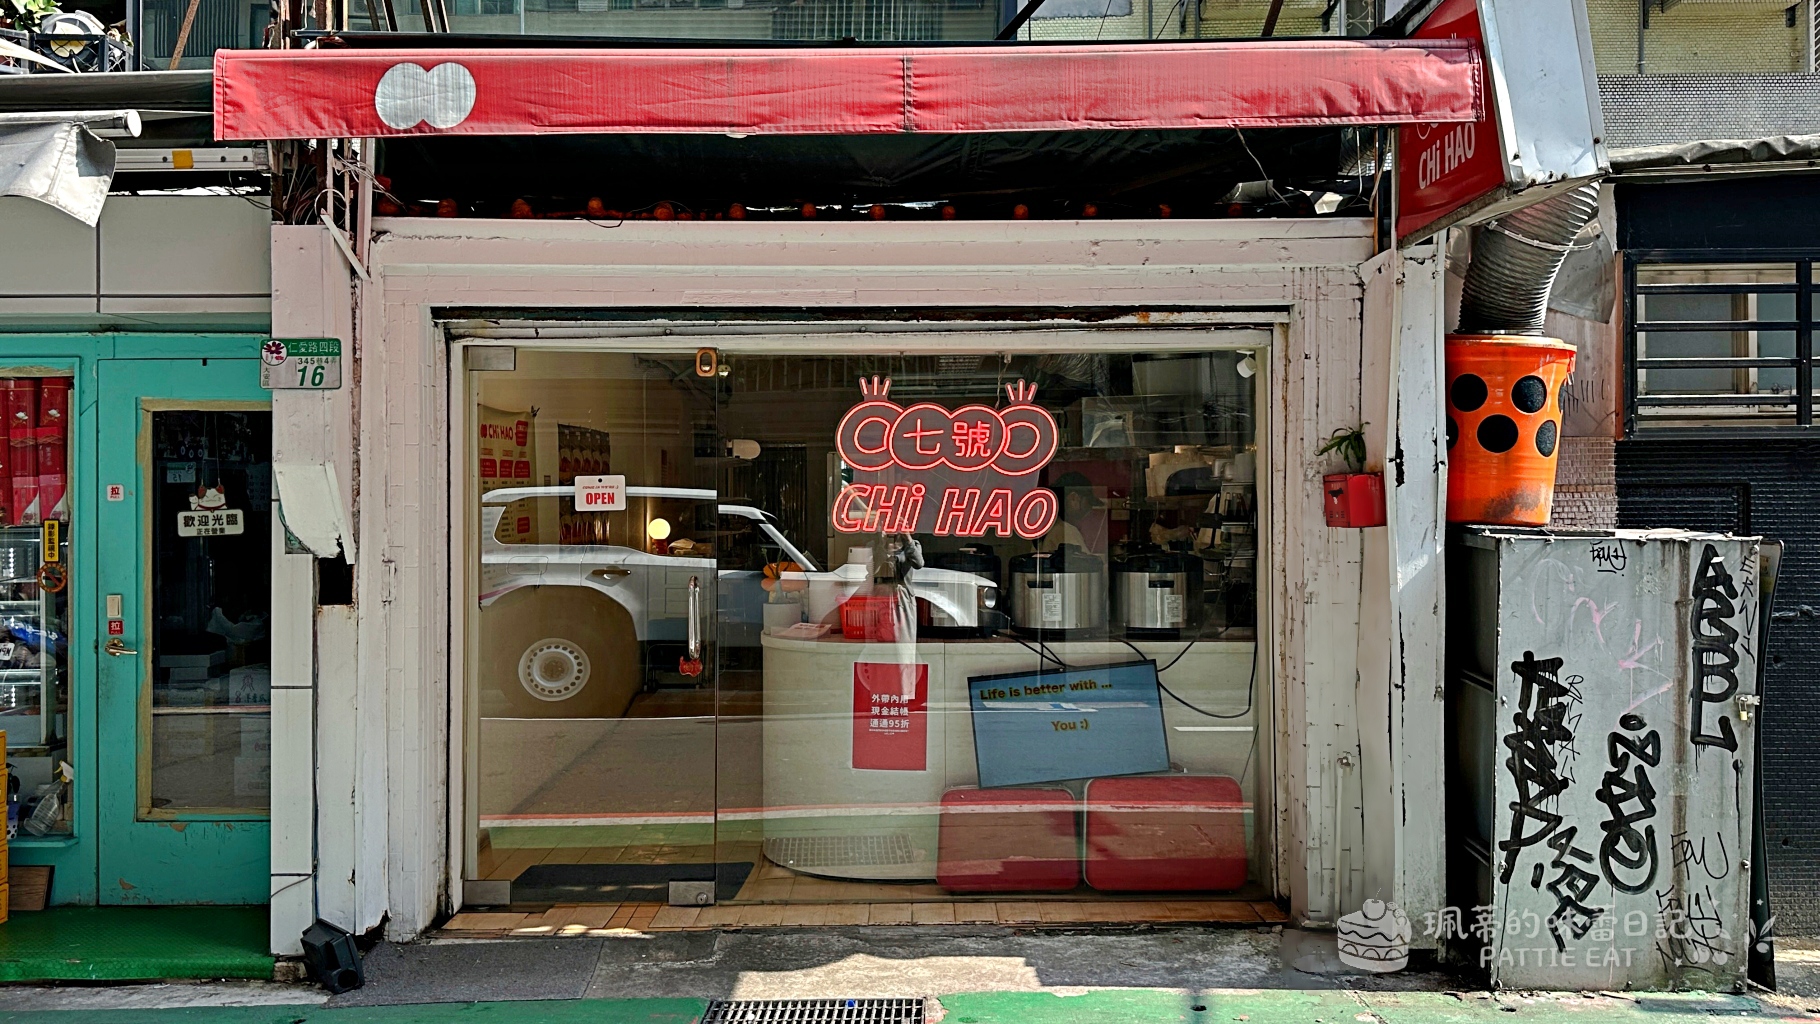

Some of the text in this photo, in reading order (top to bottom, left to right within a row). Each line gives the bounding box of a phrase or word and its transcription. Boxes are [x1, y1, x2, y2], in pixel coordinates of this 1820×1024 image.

[1418, 122, 1475, 190] CHi HAO
[288, 341, 339, 353] 仁愛路四段
[297, 365, 325, 387] 16
[902, 418, 992, 458] 七號
[110, 486, 120, 495] 拉
[586, 492, 615, 505] OPEN
[832, 482, 1058, 539] CHi HAO
[183, 513, 238, 528] 歡迎光臨
[110, 621, 120, 630] 拉
[980, 688, 1005, 700] Life
[1008, 687, 1021, 698] is
[1024, 683, 1065, 696] better
[1069, 679, 1097, 691] with
[870, 718, 910, 729] 通通95折
[1051, 719, 1076, 731] You
